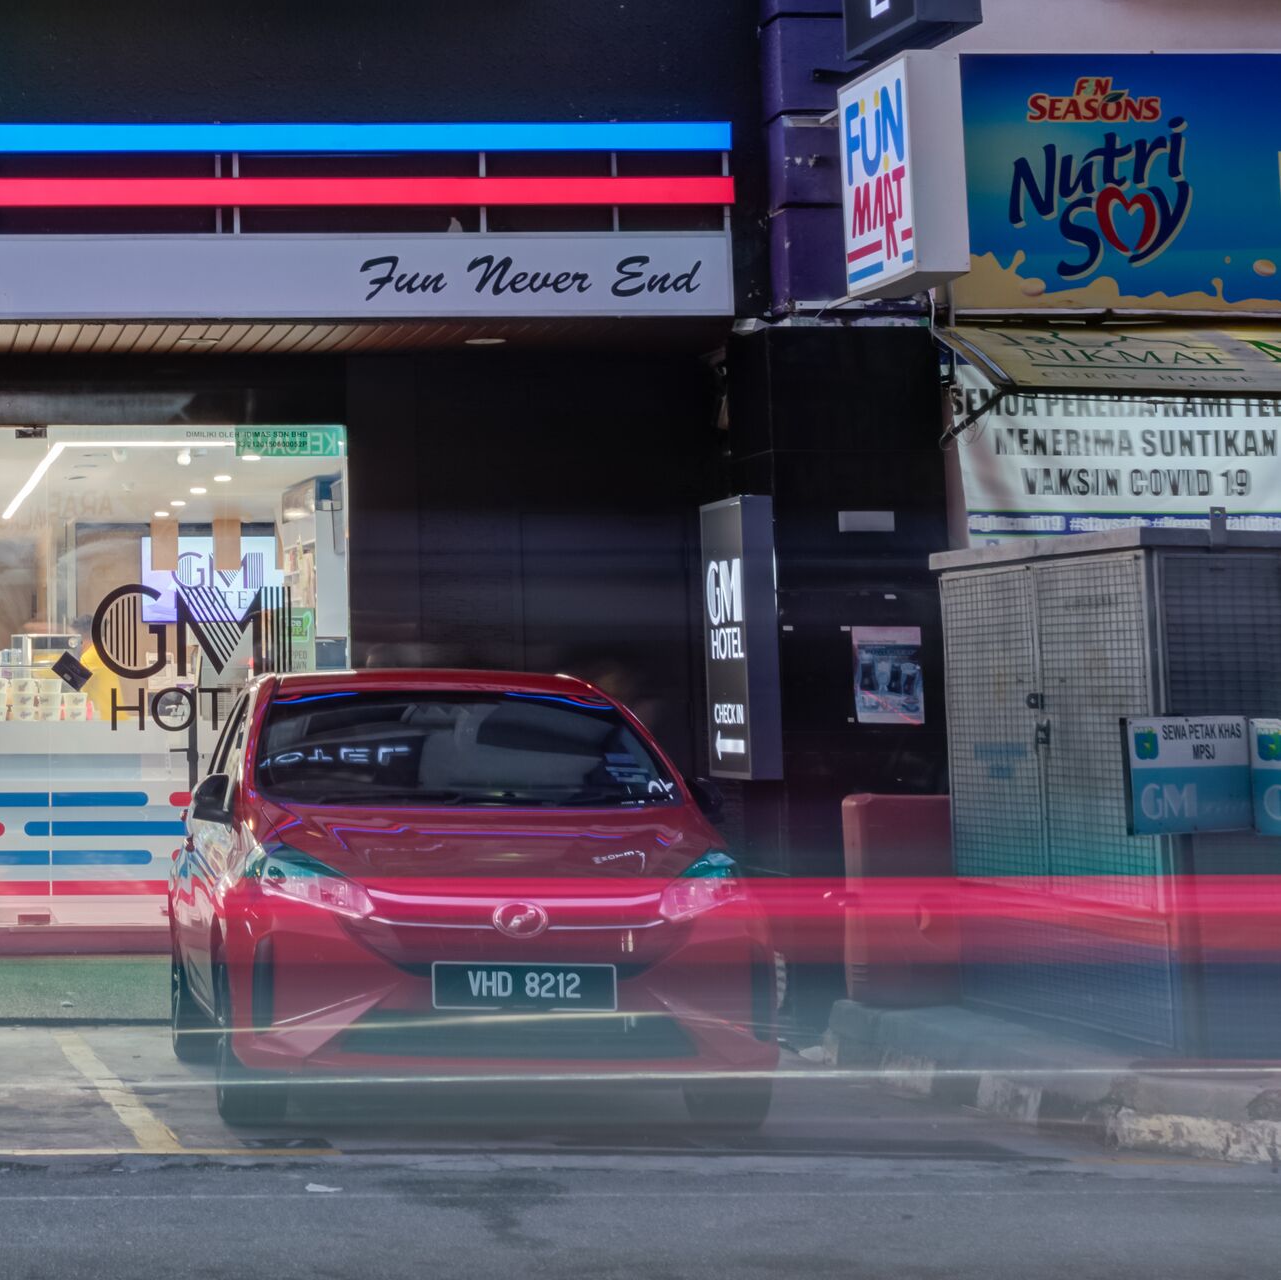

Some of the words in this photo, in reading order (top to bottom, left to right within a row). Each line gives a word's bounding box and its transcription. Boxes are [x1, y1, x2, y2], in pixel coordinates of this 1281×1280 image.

[1028, 94, 1161, 121] SEASONS
[845, 78, 905, 186] FUN
[1008, 116, 1186, 225] Nutri
[852, 165, 905, 260] MART
[359, 255, 448, 301] Fun
[466, 254, 593, 296] Never
[612, 255, 703, 296] End
[1020, 348, 1223, 365] NIKMAT
[1142, 429, 1278, 457] SUNTIKAN
[1021, 468, 1119, 496] VAKSIN
[1131, 468, 1213, 496] COVID
[1221, 469, 1252, 496] 19
[706, 558, 744, 626] GM
[91, 583, 291, 679] GM
[710, 627, 745, 660] HOTEL
[111, 688, 230, 732] HOT
[714, 704, 736, 724] CHECK
[736, 704, 745, 724] IN
[1162, 724, 1188, 740] SEWA
[1189, 723, 1217, 739] PETAK
[1219, 723, 1242, 738] KHAS
[1192, 744, 1216, 760] MPSJ
[468, 970, 513, 996] VHD
[524, 971, 582, 998] 8212
